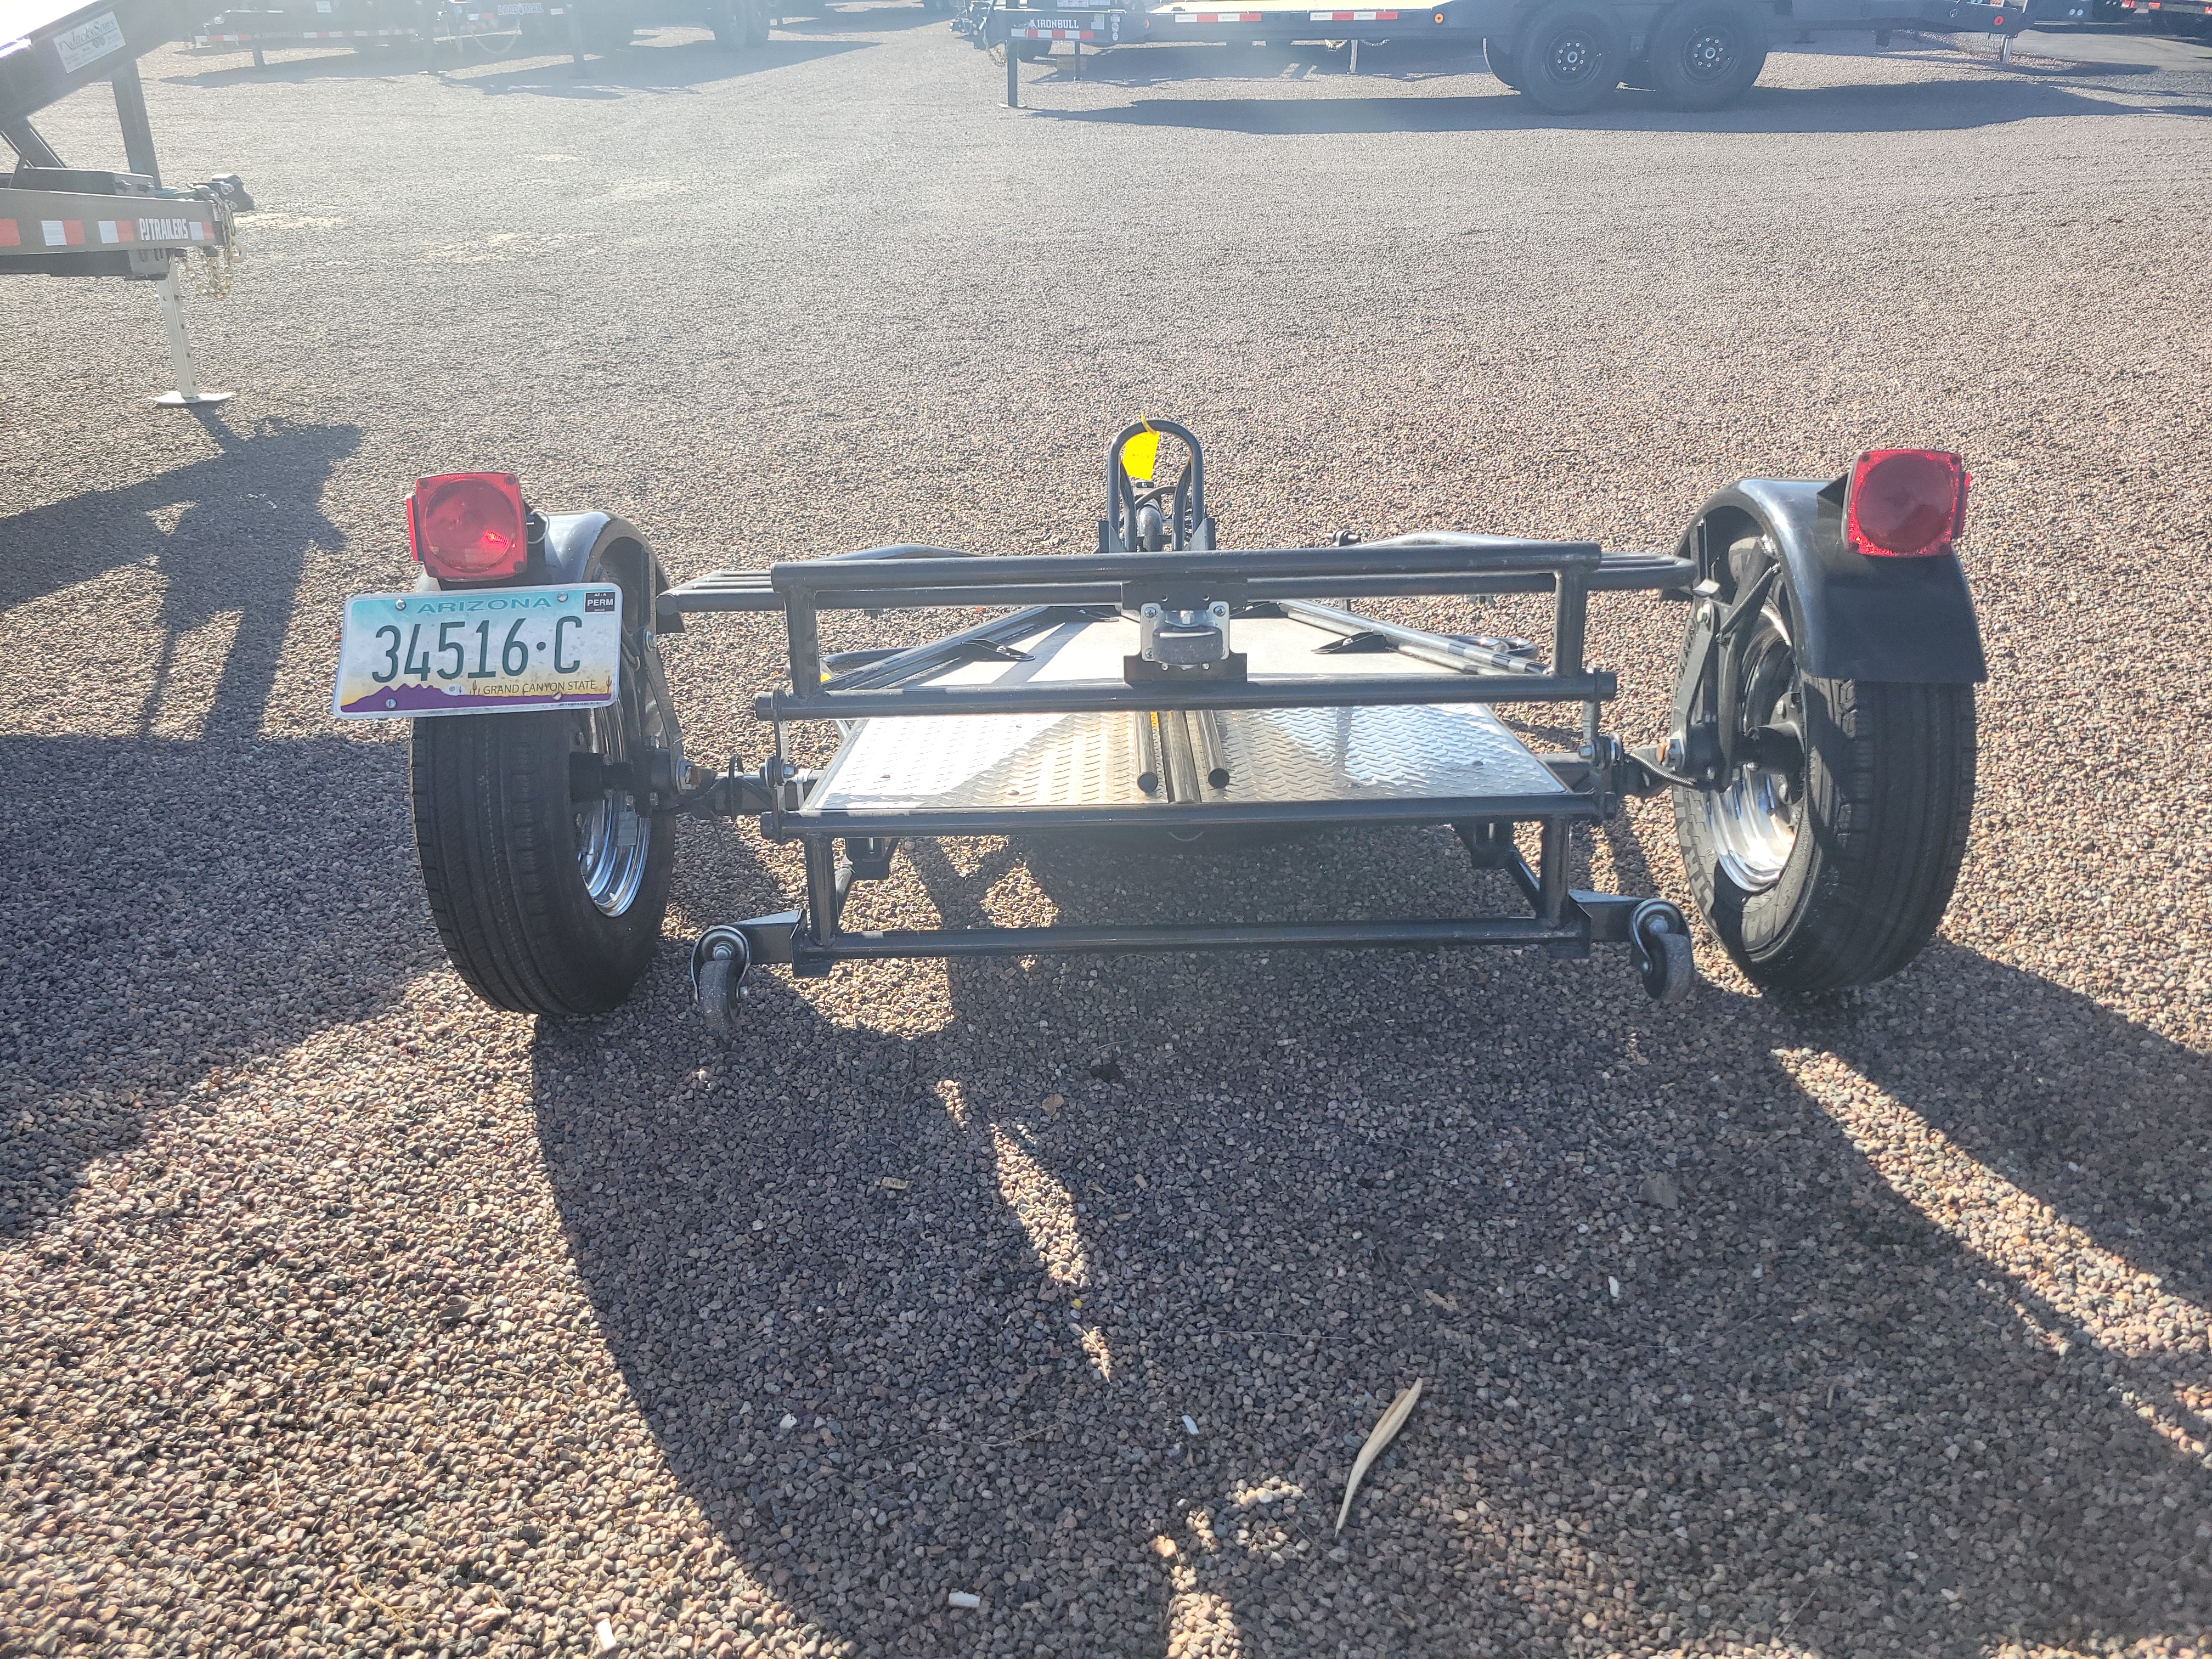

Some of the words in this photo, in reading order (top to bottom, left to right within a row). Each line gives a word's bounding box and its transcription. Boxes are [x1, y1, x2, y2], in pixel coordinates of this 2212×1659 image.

[498, 4, 518, 15] LOAD
[521, 3, 544, 14] TRAIL
[1037, 19, 1079, 29] IRONBULL
[416, 597, 552, 614] ARIZONA
[587, 598, 613, 607] PERM
[483, 684, 520, 695] GRAND
[522, 682, 565, 693] CANYON
[567, 680, 596, 691] STATE
